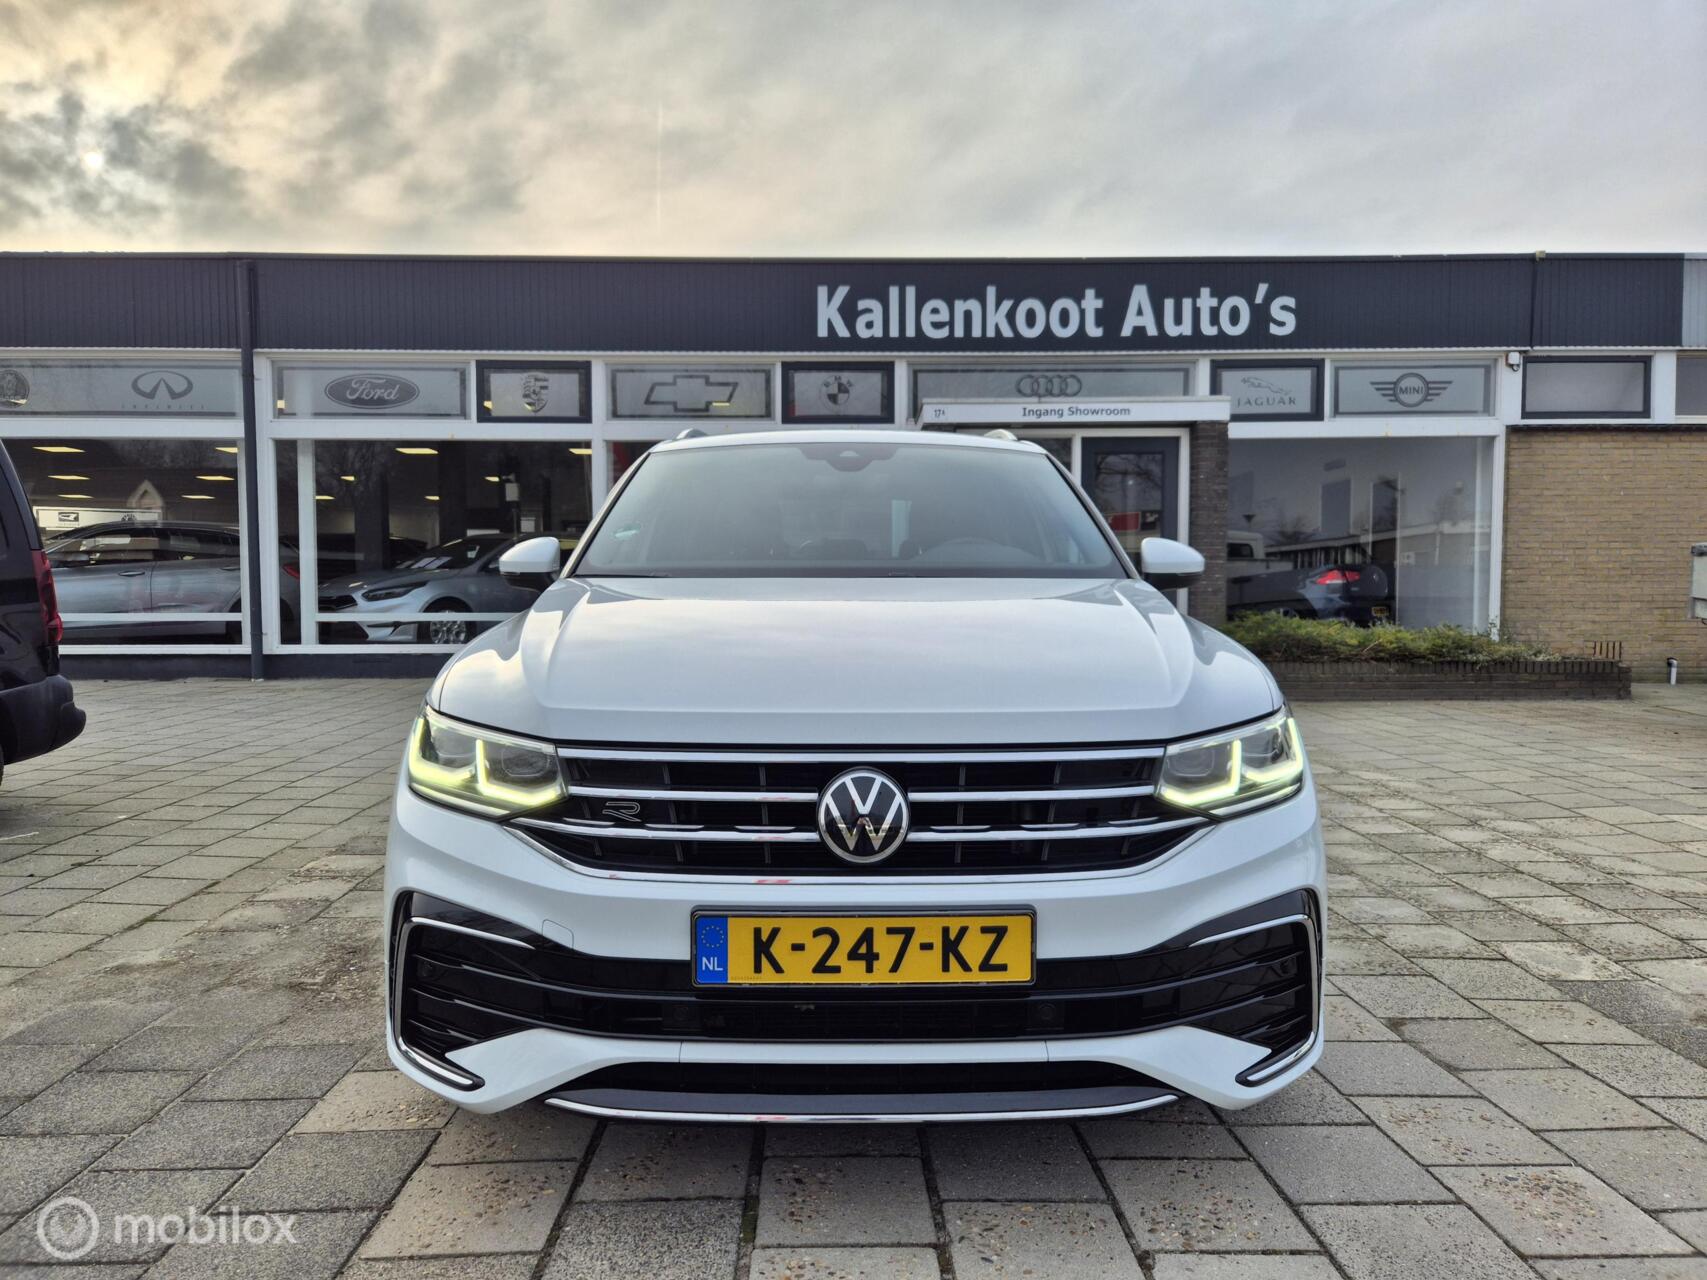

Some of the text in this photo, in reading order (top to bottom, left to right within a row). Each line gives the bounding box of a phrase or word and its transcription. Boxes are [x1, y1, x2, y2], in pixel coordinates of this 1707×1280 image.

[816, 283, 1297, 339] Kallenkoot Auto's
[345, 375, 399, 401] Ford
[1399, 385, 1424, 395] MINI
[1237, 396, 1296, 408] JAGUAR
[1022, 406, 1131, 419] Ingang Showroom
[752, 925, 1009, 974] K-247-KZ
[702, 956, 724, 971] NL
